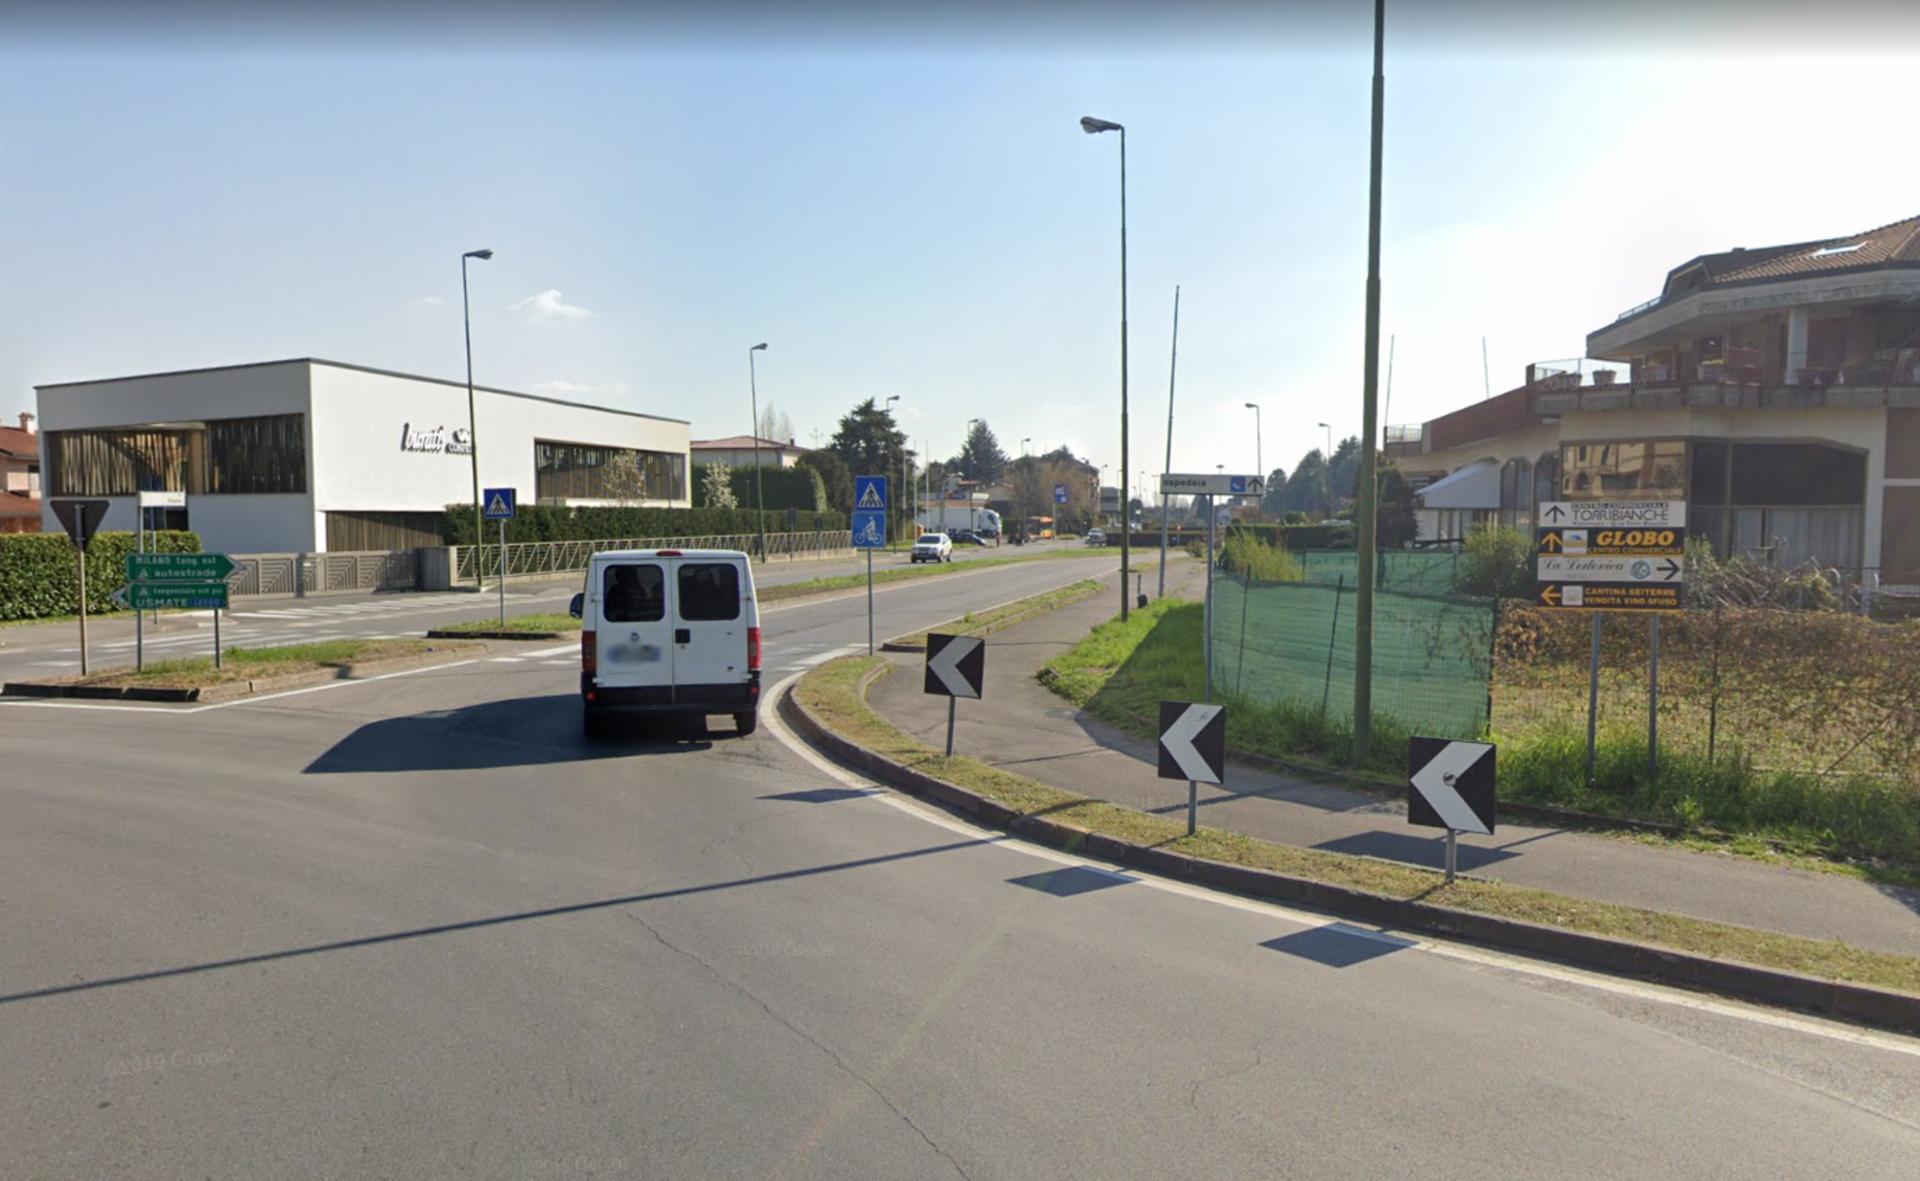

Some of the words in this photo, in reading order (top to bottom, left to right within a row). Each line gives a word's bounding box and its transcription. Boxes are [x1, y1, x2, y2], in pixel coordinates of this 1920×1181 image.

[1163, 478, 1207, 488] ospedale
[1596, 530, 1675, 546] GLOBO
[135, 556, 171, 564] MILANO
[202, 556, 217, 564] est
[154, 568, 217, 577] autostrade
[1584, 587, 1626, 596] CANTINA
[135, 598, 188, 607] USMATE
[1584, 597, 1622, 606] VENDITA
[1624, 597, 1646, 606] VINO
